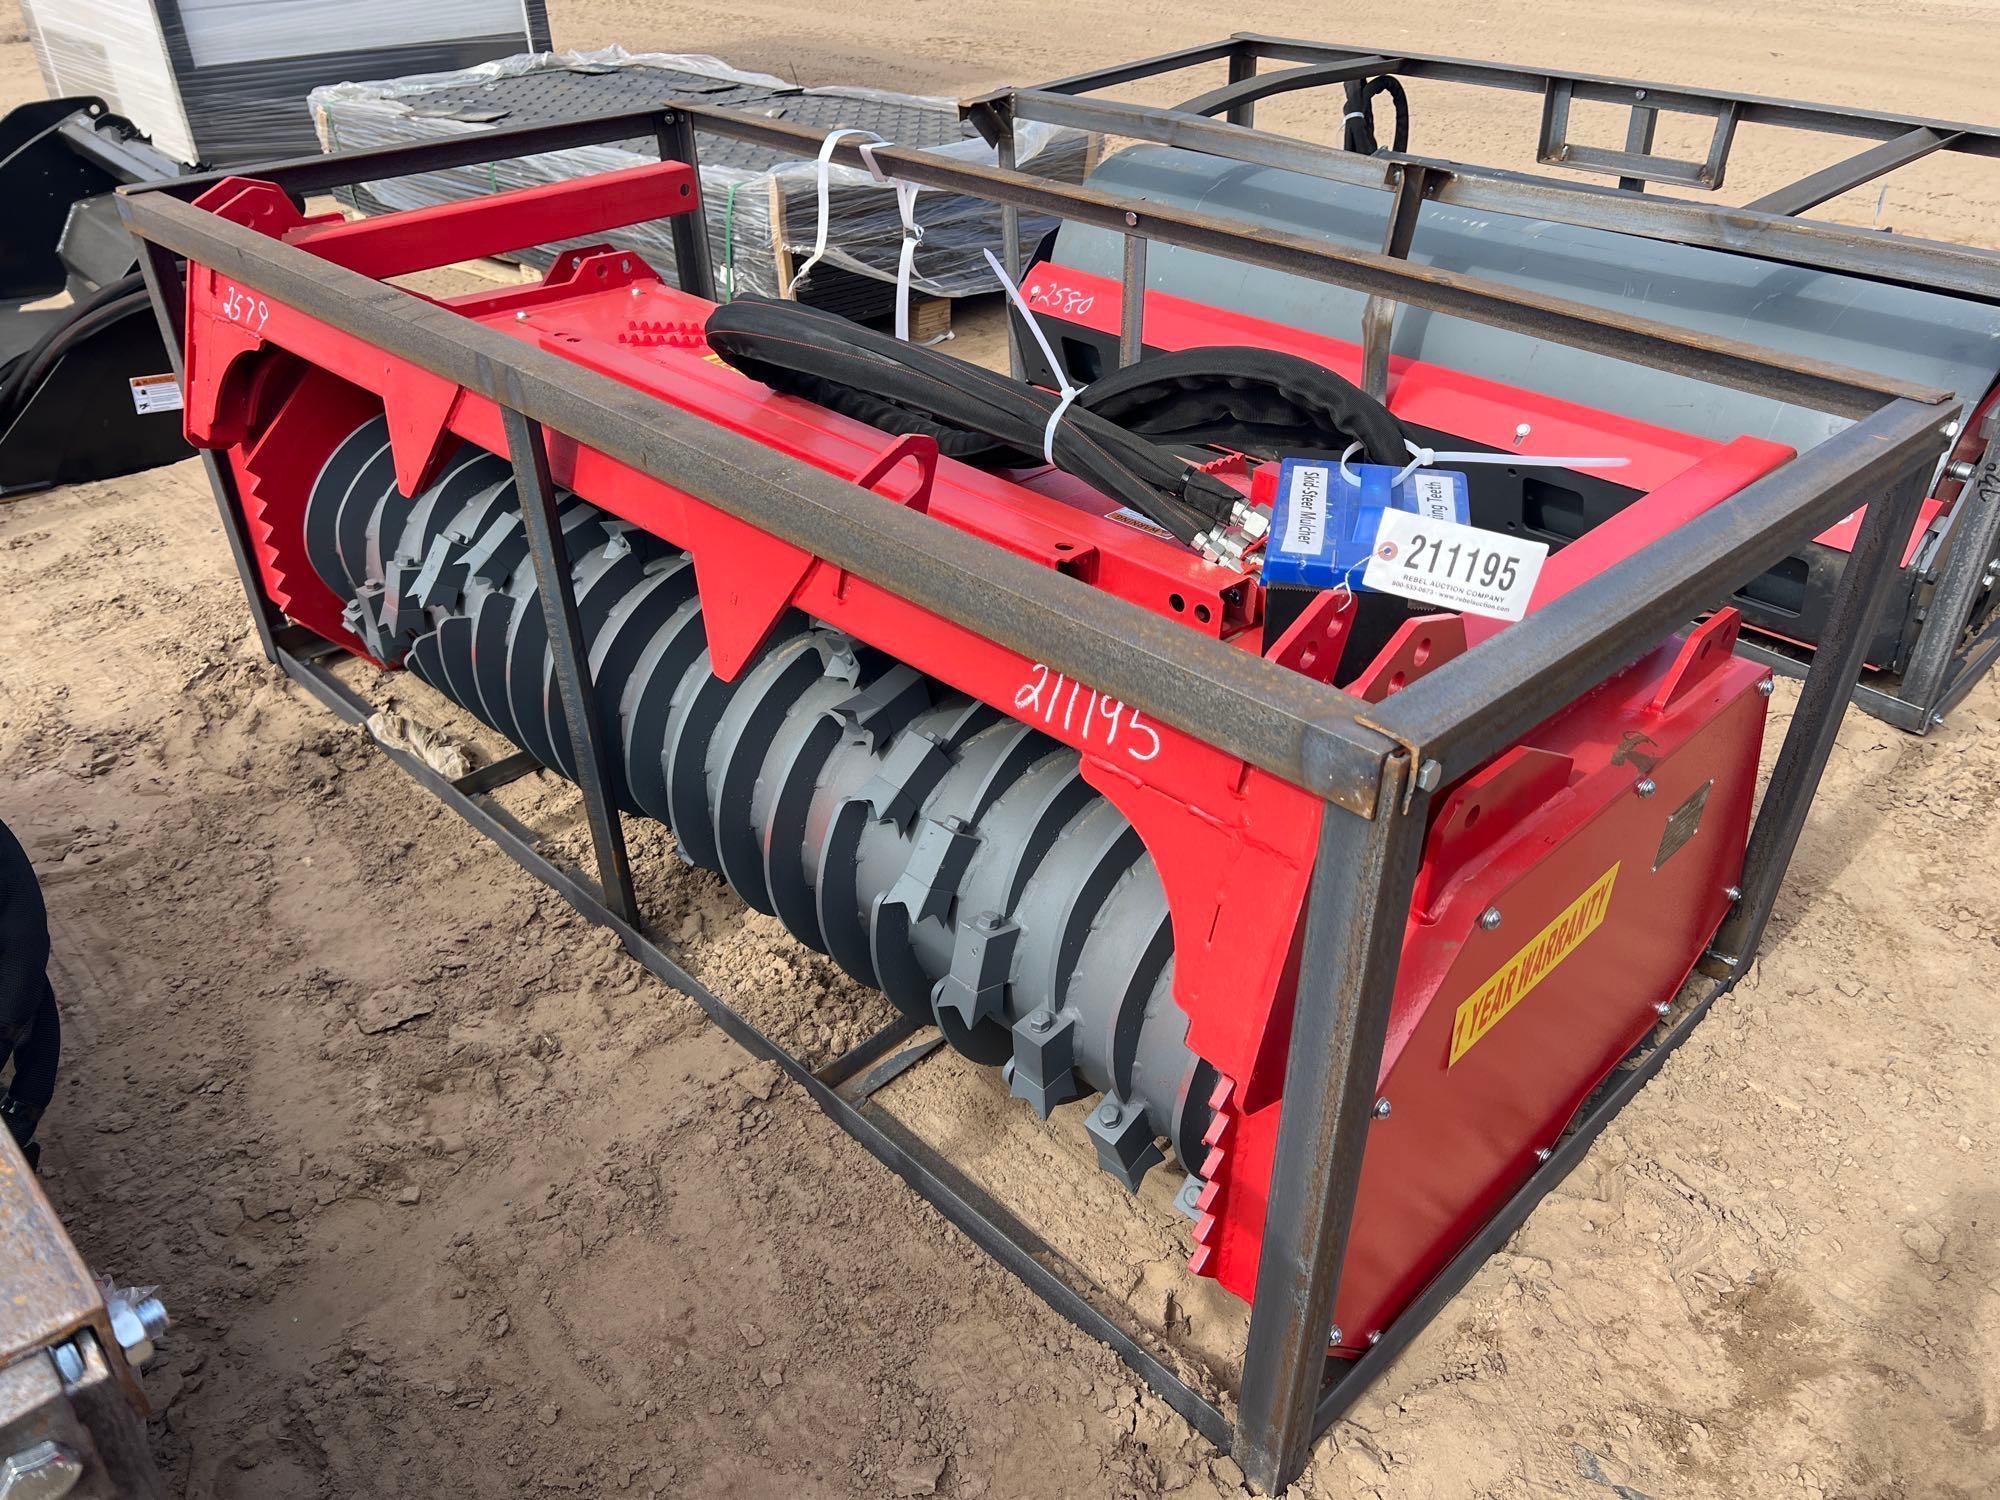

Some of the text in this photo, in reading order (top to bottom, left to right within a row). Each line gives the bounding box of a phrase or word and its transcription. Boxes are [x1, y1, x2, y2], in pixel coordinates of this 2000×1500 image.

[222, 286, 269, 332] 2579
[1037, 281, 1095, 315] 2580
[1297, 471, 1320, 545] Skid-Steer Mulcher
[1424, 481, 1443, 502] Teeth
[1115, 514, 1160, 534] WARNING
[1403, 534, 1521, 592] 211195
[1403, 574, 1505, 603] REBEL AUCTION COMPANY
[1014, 663, 1161, 761] 211195
[1454, 877, 1612, 1054] 1 YEAR WARRANTY
